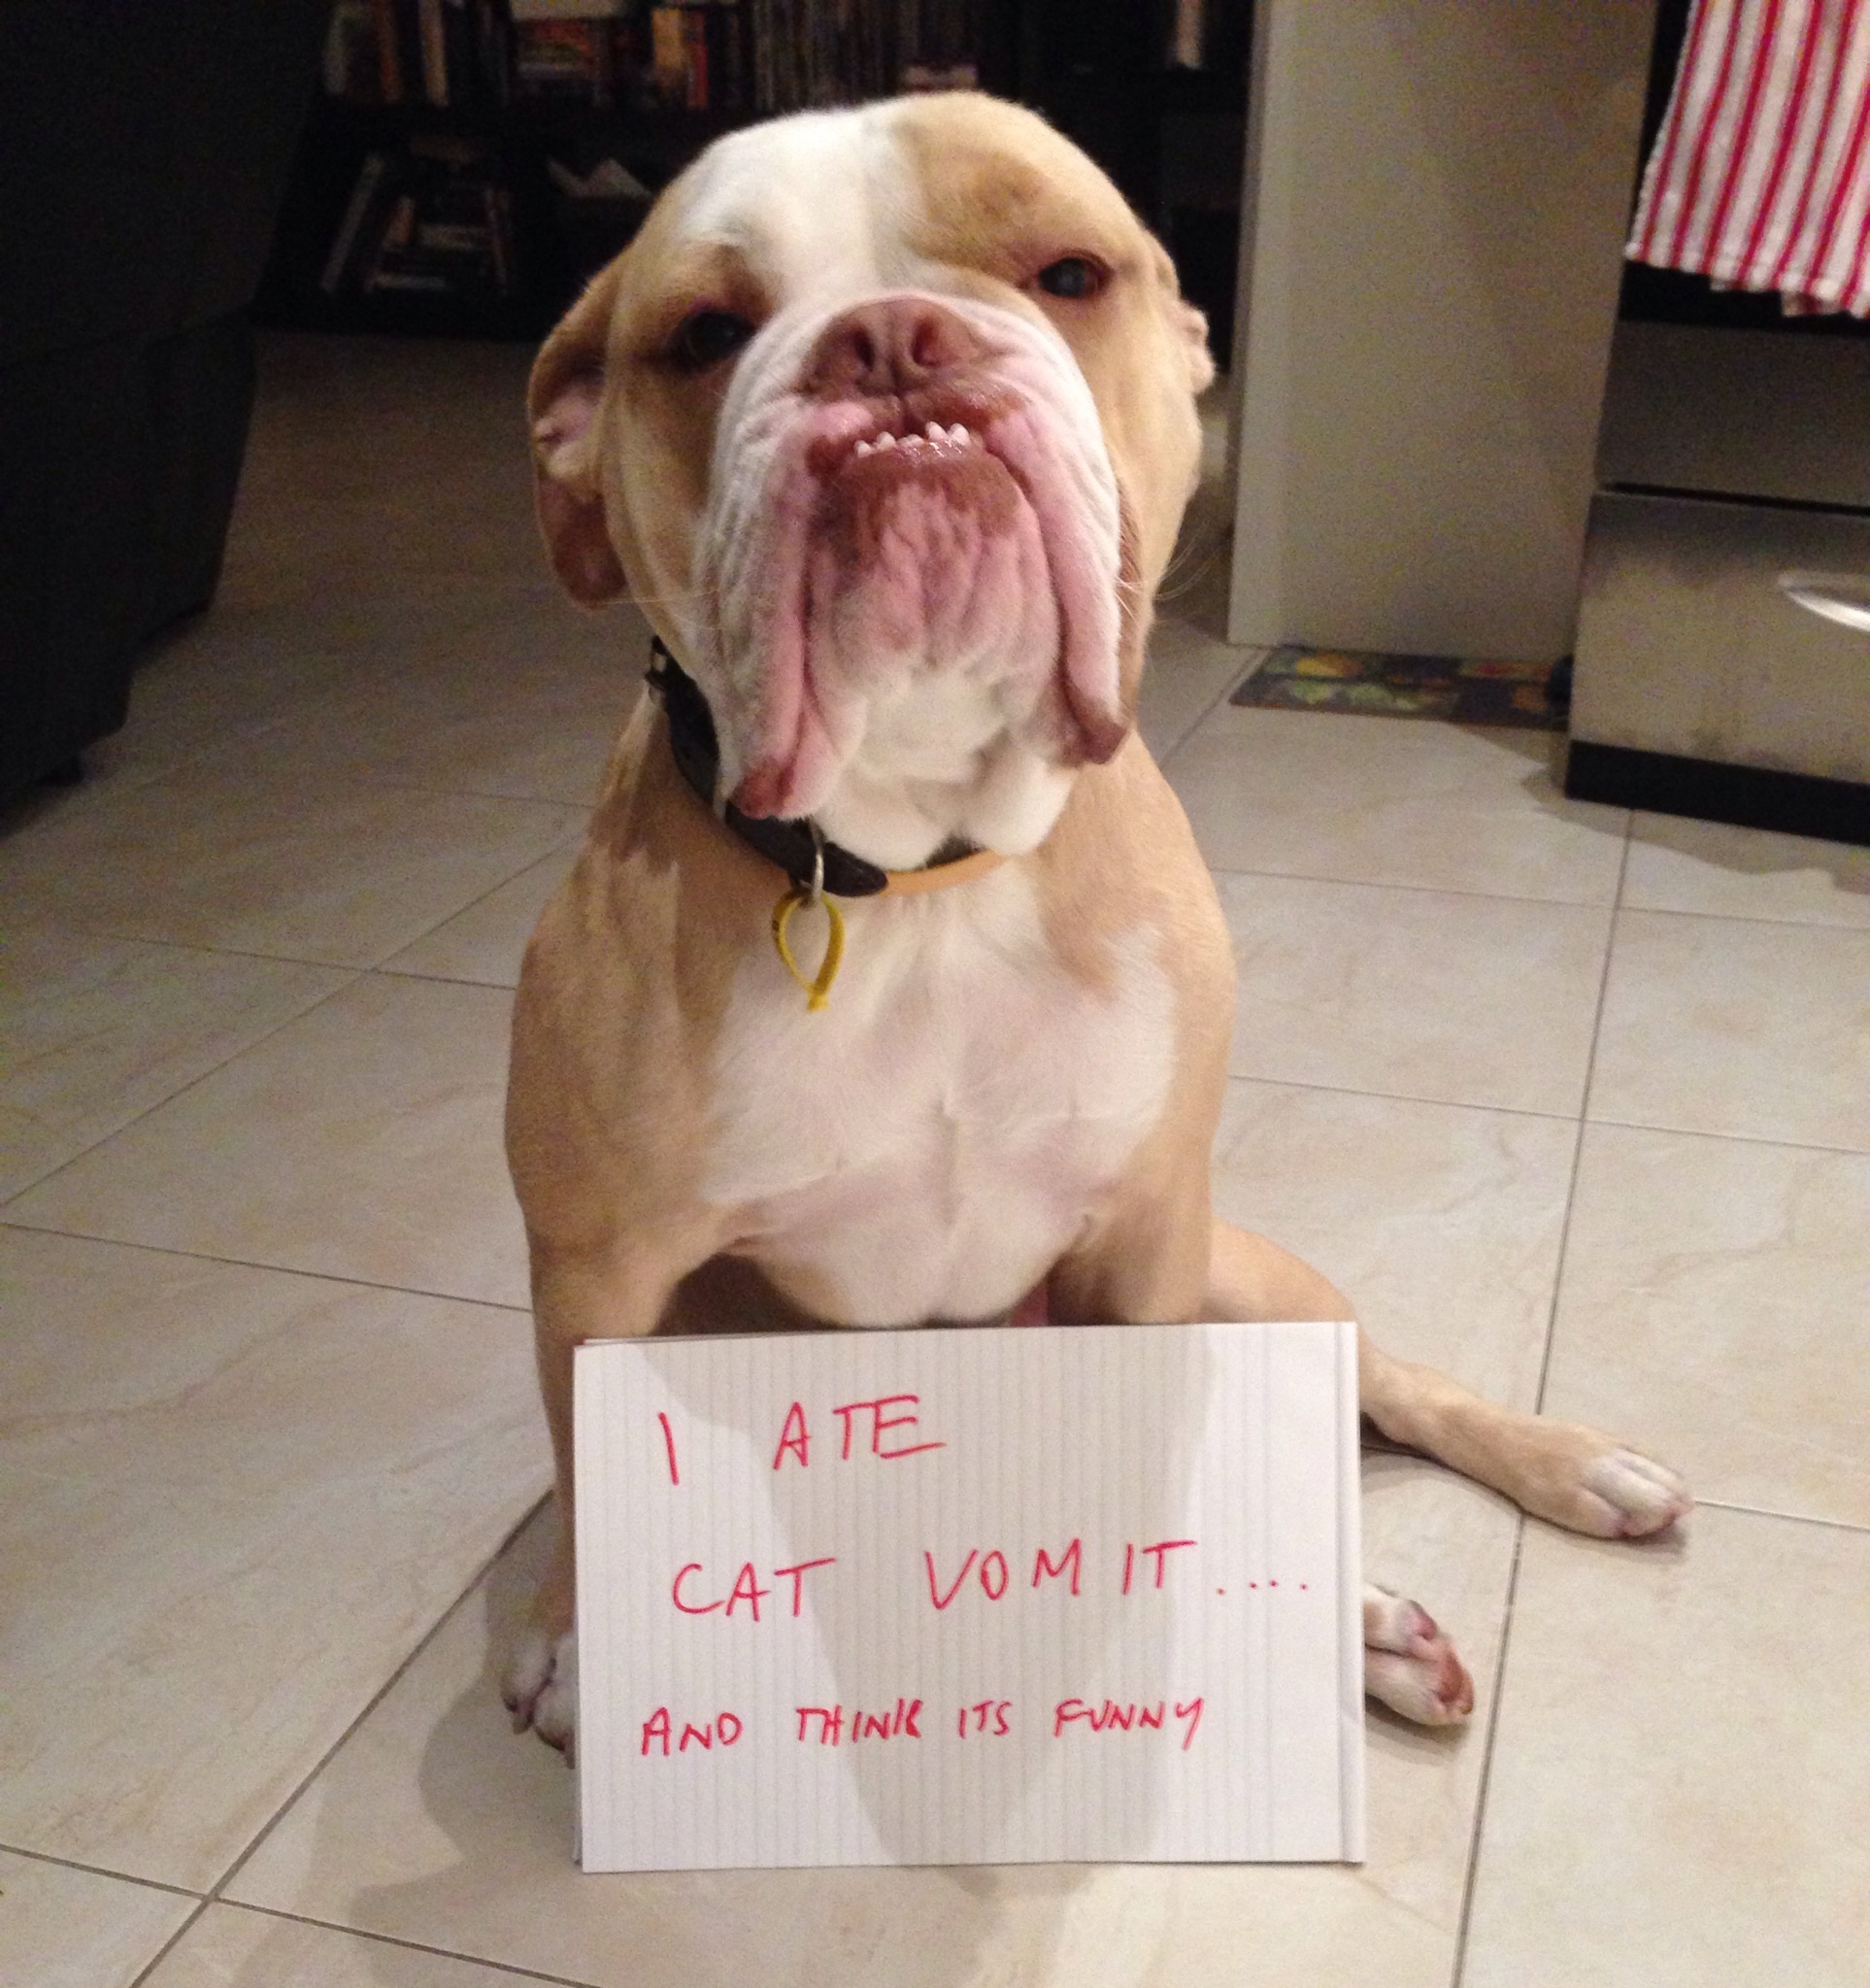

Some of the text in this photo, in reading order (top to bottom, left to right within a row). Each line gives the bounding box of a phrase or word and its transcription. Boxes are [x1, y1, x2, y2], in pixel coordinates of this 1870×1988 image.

[657, 1393, 947, 1487] I ATE
[671, 1556, 837, 1623] CAT
[640, 1697, 1205, 1757] AND THINK ITS FUNNY
